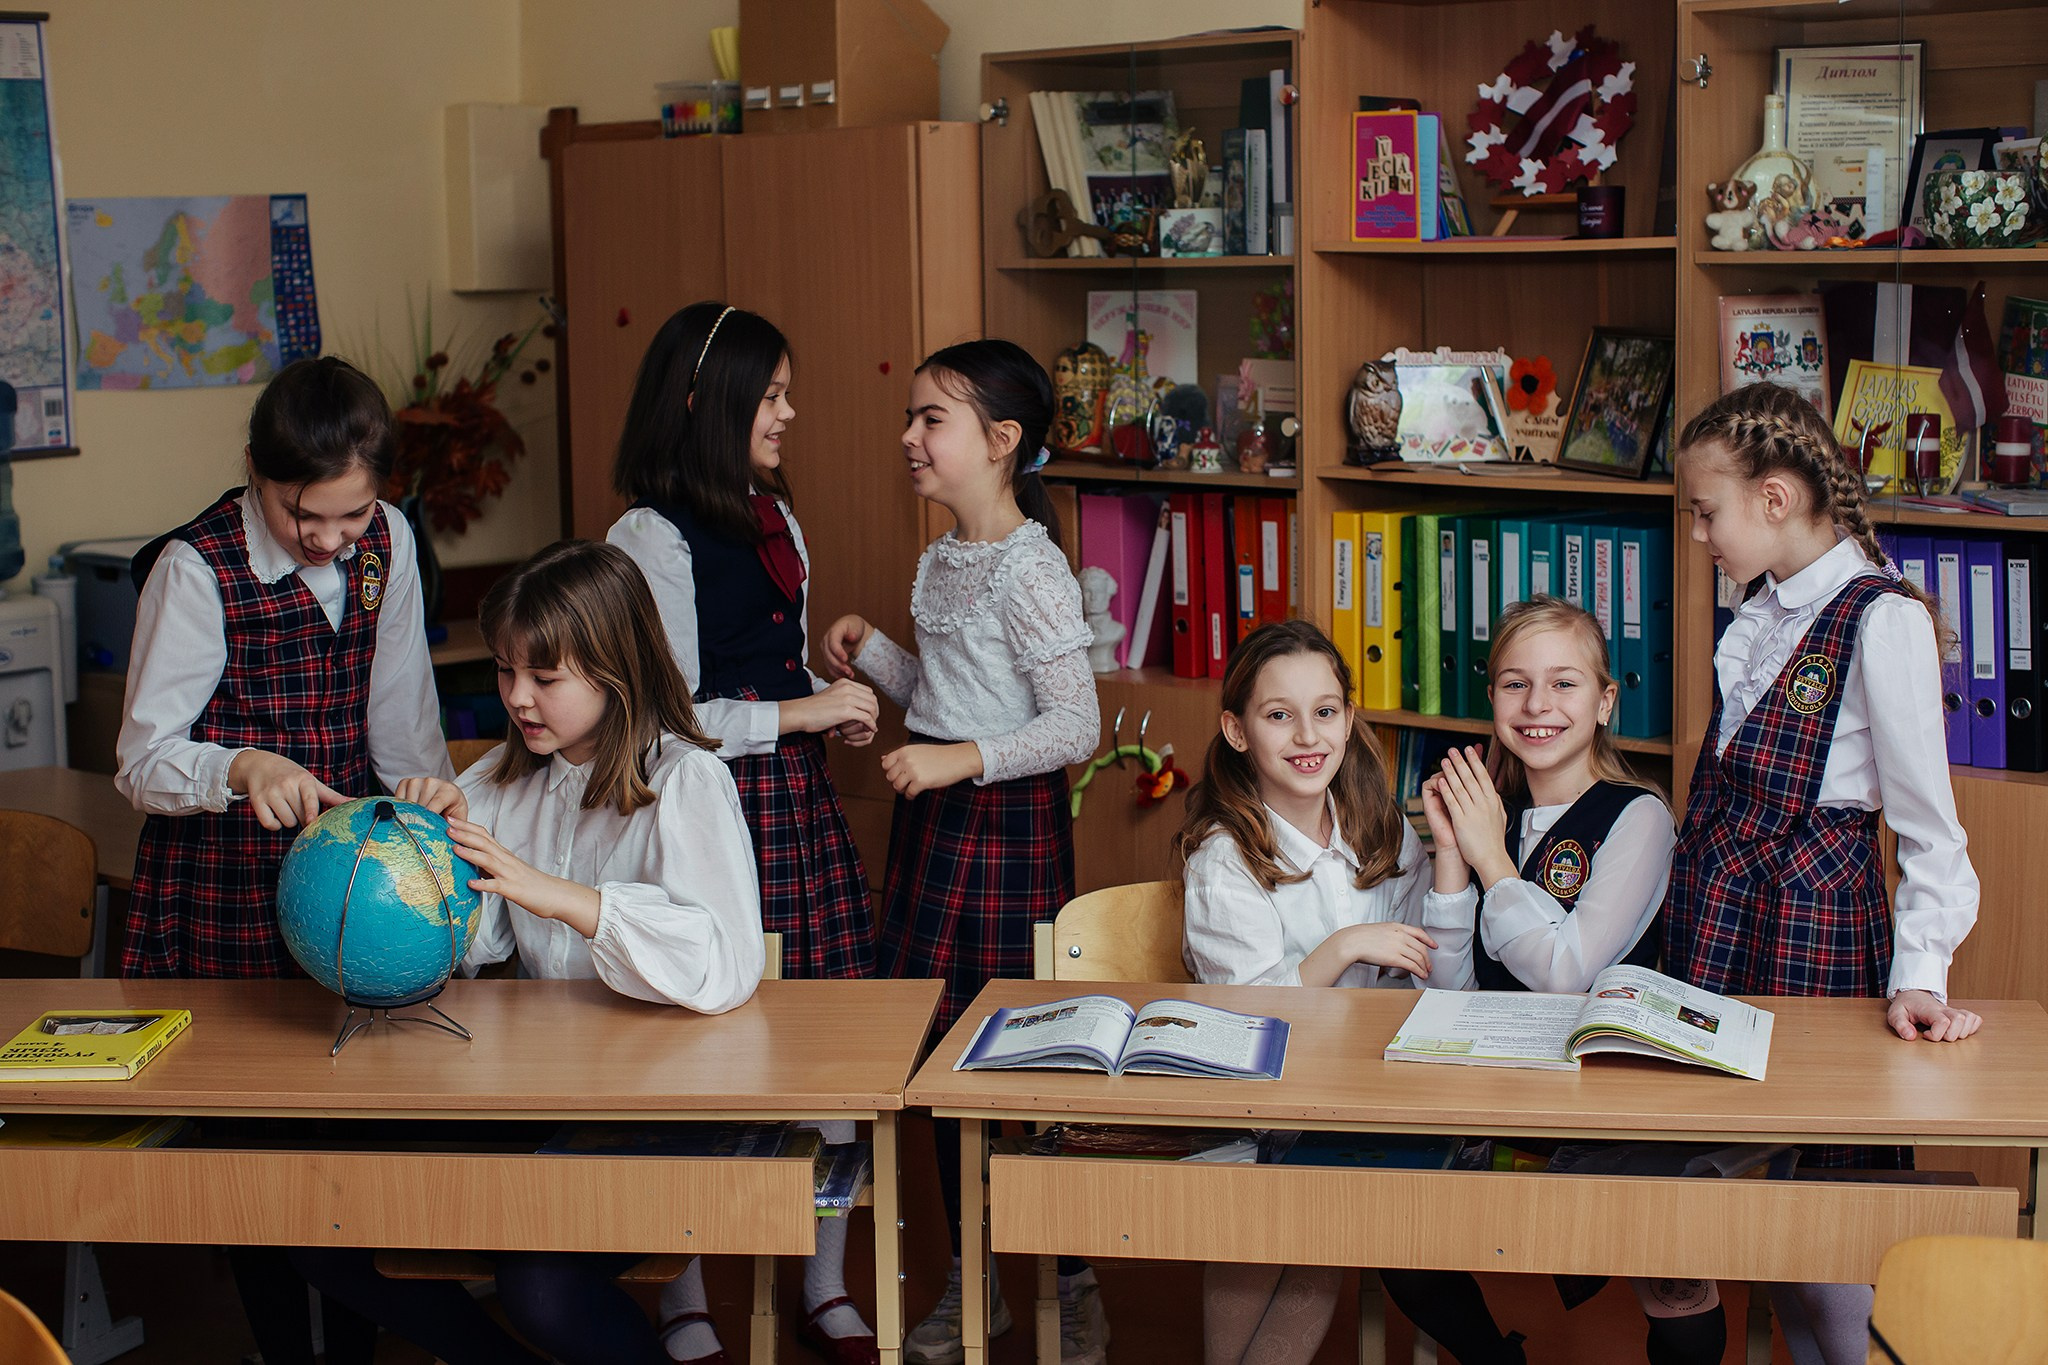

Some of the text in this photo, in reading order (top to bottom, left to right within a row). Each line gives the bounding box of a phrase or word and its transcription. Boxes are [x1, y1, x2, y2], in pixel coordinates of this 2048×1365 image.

[1815, 66, 1877, 81] Диплом
[1858, 374, 1919, 403] LATVIJAS
[2007, 375, 2044, 392] LATVIJAS
[1568, 541, 1580, 598] Демид
[1788, 690, 1823, 711] VIDUSSKOLA
